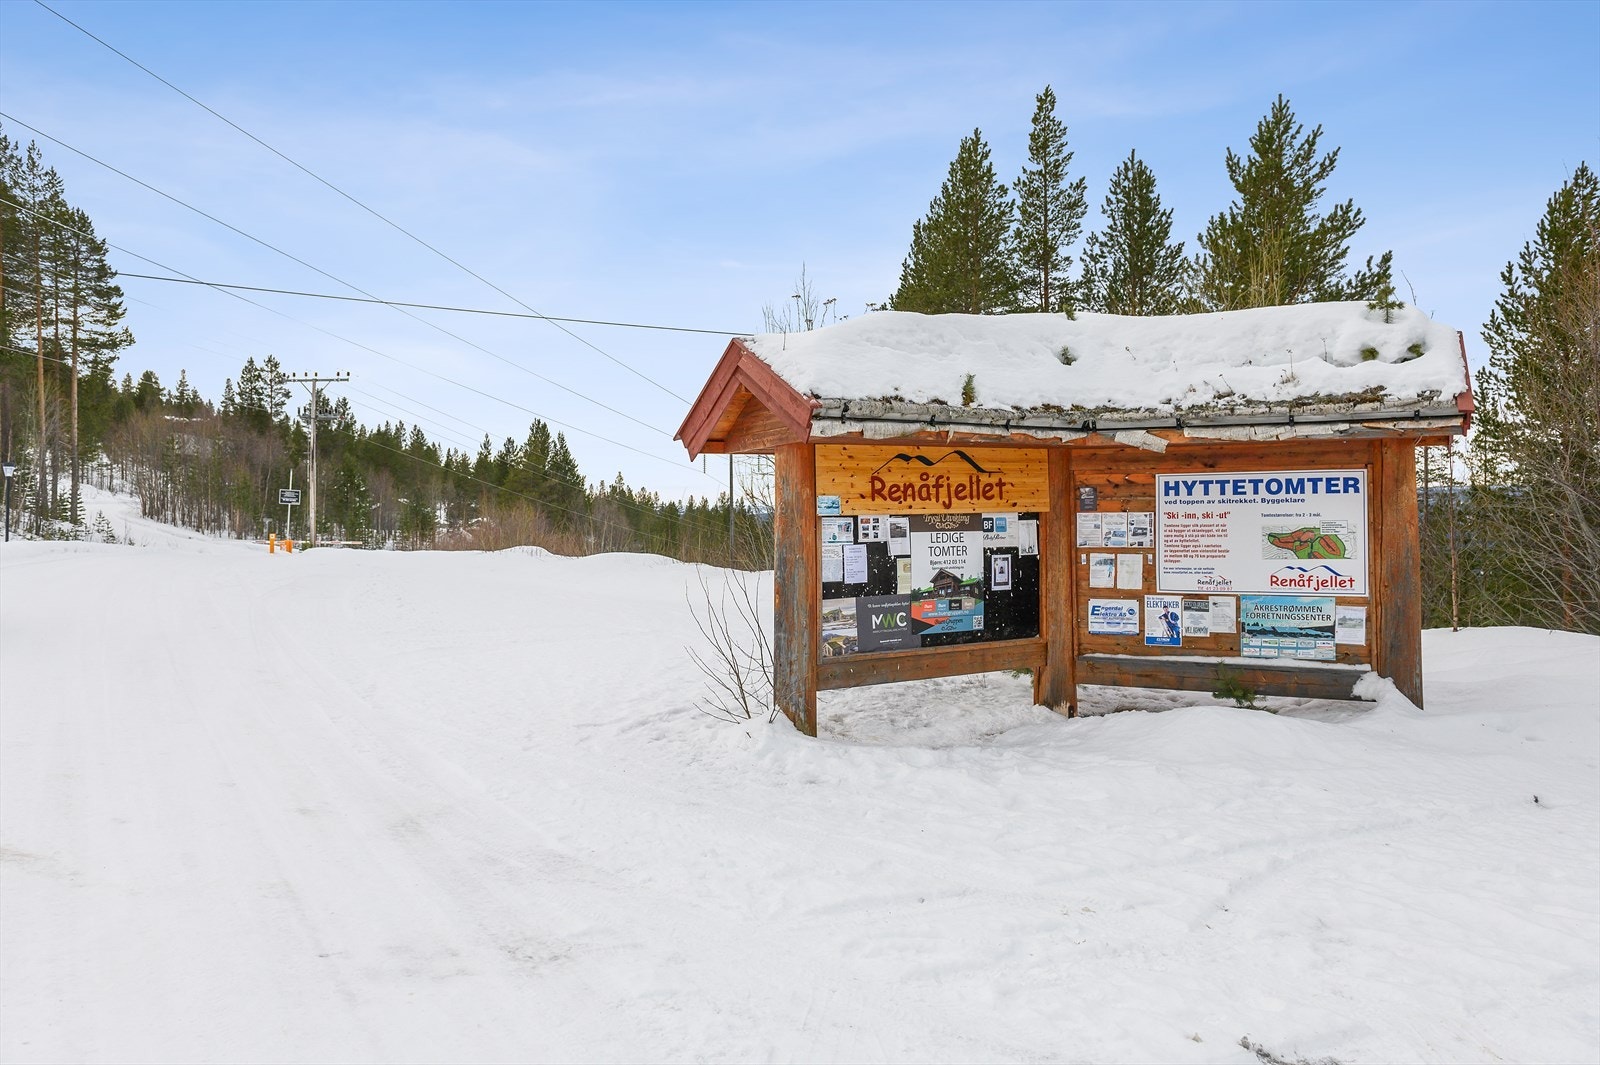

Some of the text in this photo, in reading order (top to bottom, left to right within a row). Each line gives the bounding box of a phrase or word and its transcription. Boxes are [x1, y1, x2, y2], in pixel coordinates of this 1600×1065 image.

[870, 472, 1006, 509] Renåfjellet
[1164, 477, 1360, 497] HYTTETOMTER
[1181, 512, 1199, 520] -inn,
[1202, 511, 1213, 519] ski
[1216, 511, 1231, 519] -ut"
[984, 521, 993, 529] BF
[930, 532, 964, 544] LEDIGE
[928, 546, 968, 556] TOMTER
[1270, 574, 1355, 591] Renåfjellet
[1254, 603, 1322, 612] ÅKRESTRØMMEN
[872, 612, 907, 629] MWC
[1246, 612, 1331, 621] FORRETNINGSSENTER
